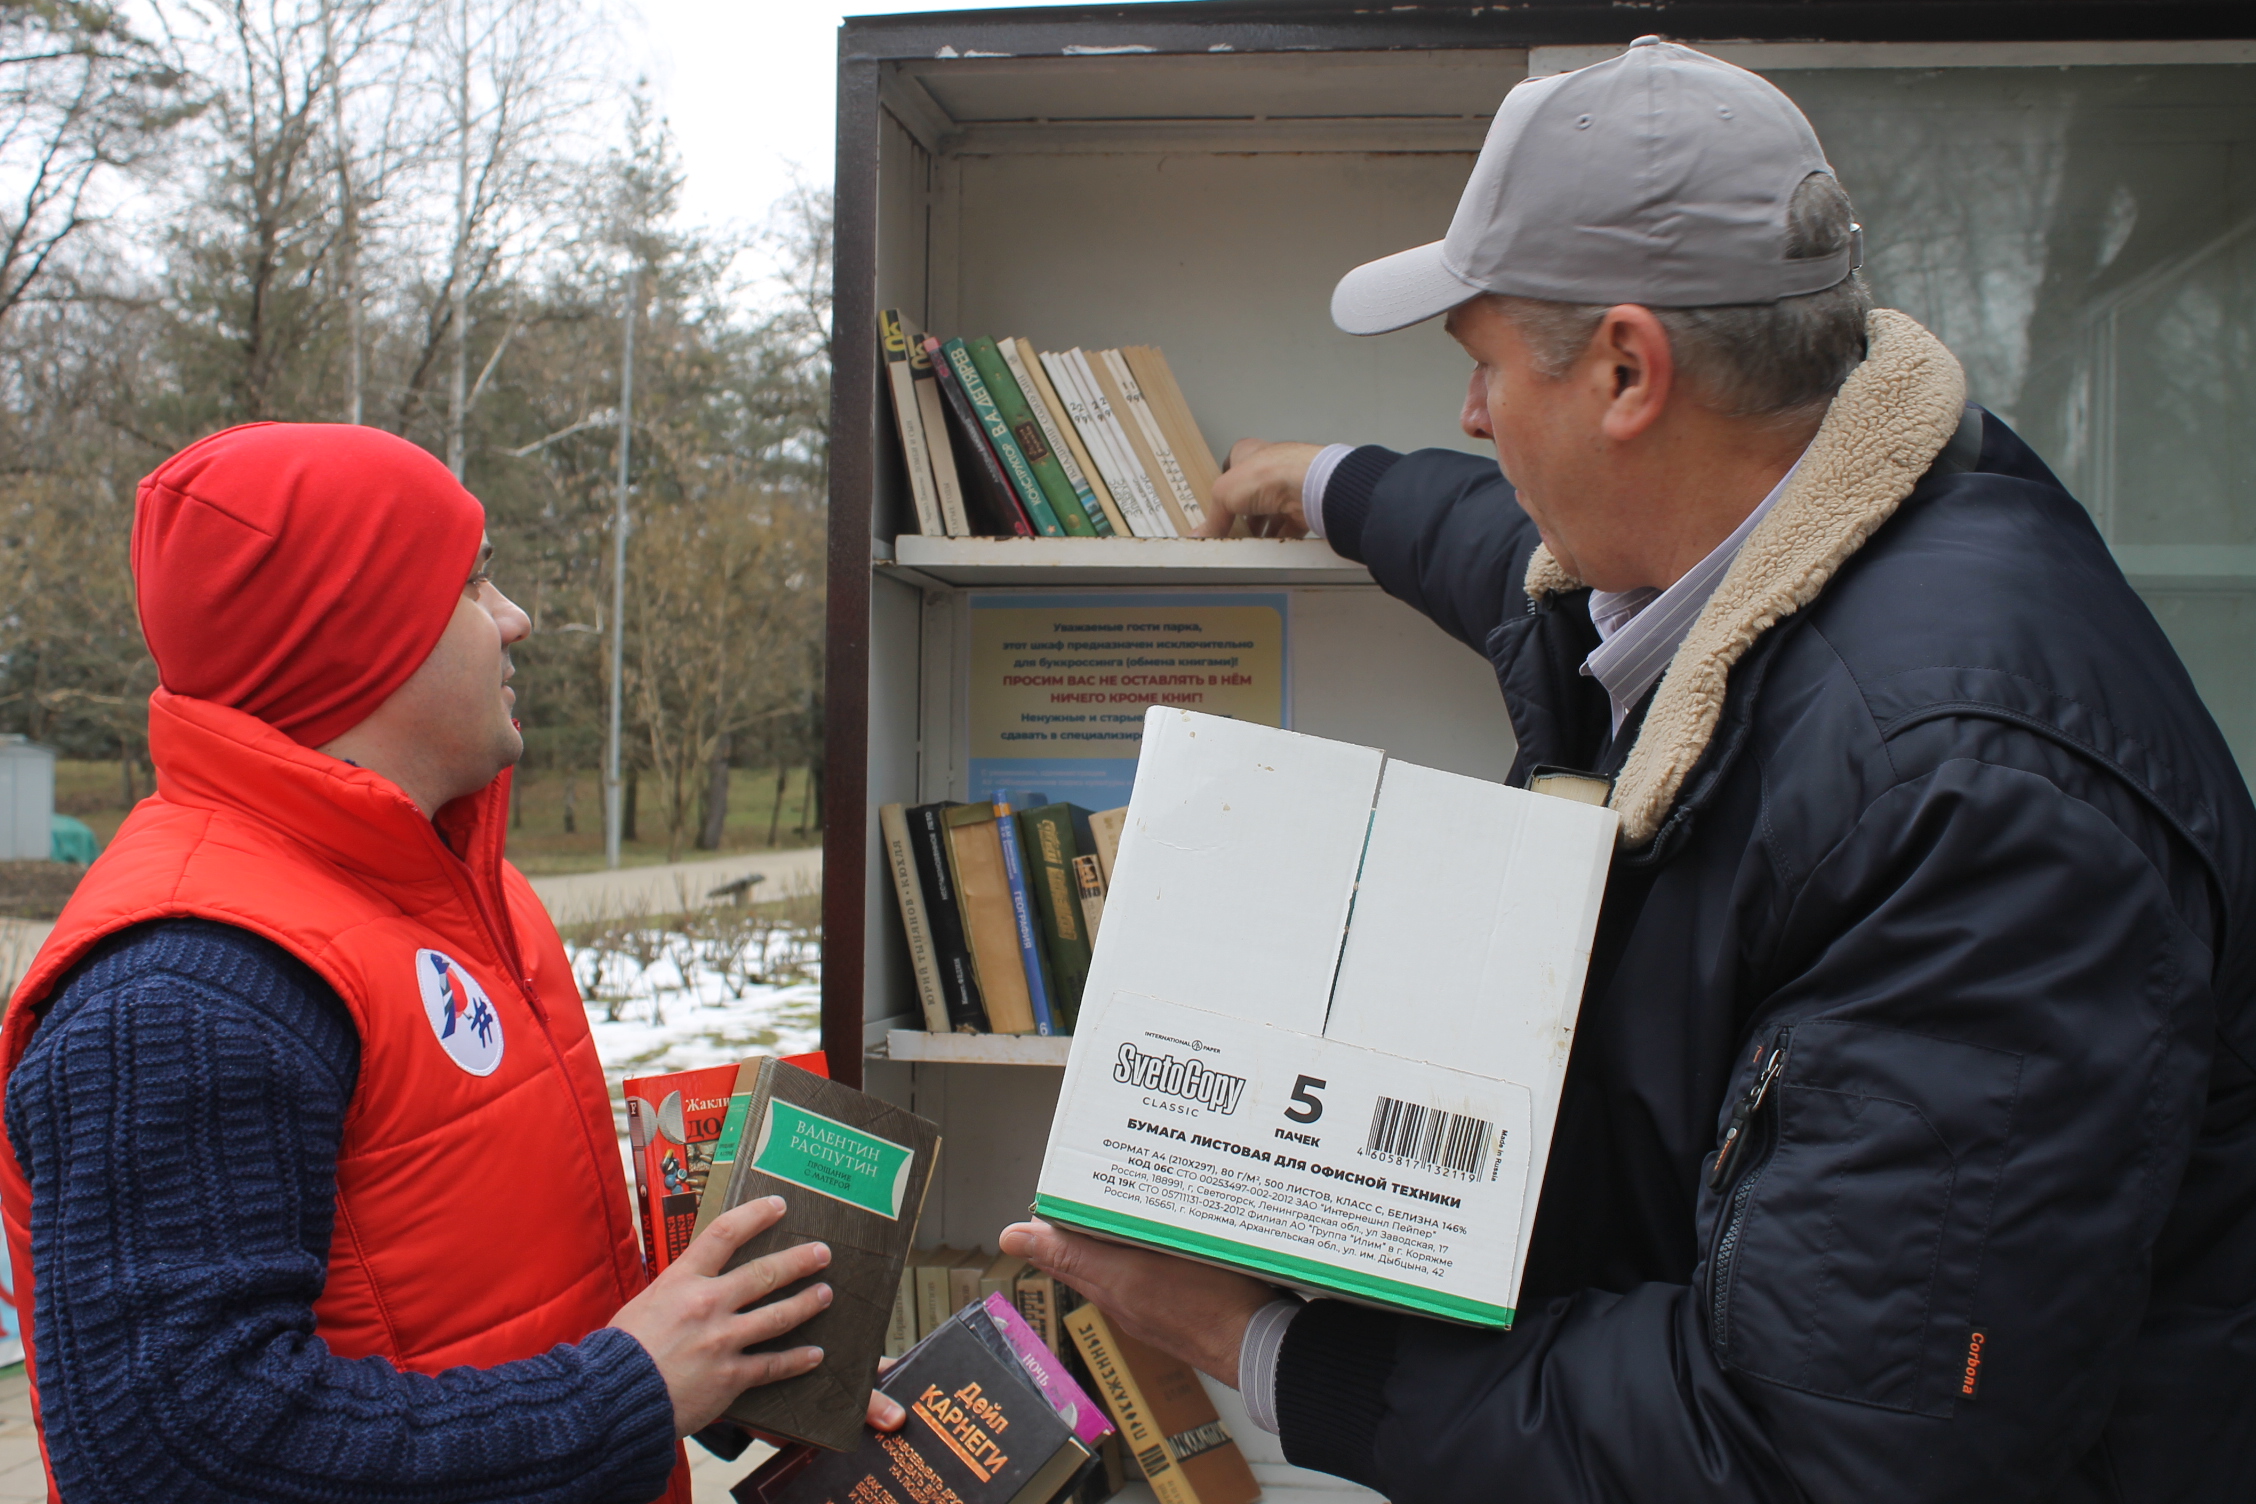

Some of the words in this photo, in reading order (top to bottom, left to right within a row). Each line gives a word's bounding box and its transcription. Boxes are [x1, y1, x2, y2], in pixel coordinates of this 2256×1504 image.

[951, 346, 992, 407] ДЕГТЯРЕВ
[1017, 374, 1047, 425] СОЛОУХИН
[1045, 426, 1078, 479] ВЛАДИМИР
[1001, 443, 1041, 506] КОНСТРУКТОР
[1003, 642, 1027, 650] этот
[1030, 641, 1064, 652] шкаф
[1067, 641, 1153, 651] предназначен
[1156, 640, 1254, 649] исключительно
[1053, 622, 1124, 633] Уважаемые
[1126, 623, 1160, 631] гости
[1163, 623, 1202, 633] парка,
[1003, 675, 1063, 686] ПРОСИМ
[1067, 675, 1095, 686] ВАС
[1100, 675, 1118, 686] НЕ
[1121, 675, 1204, 686] ОСТАВЛЯТЬ
[1208, 675, 1217, 685] В
[1220, 672, 1252, 685] НЁМ
[1013, 658, 1036, 668] для
[1039, 657, 1123, 668] буккроссинга
[1126, 657, 1176, 668] (обмена
[1178, 657, 1238, 668] книгами)!
[1050, 693, 1107, 703] НИЧЕГО
[1110, 693, 1159, 703] КРОМЕ
[1161, 692, 1203, 703] КНИГ!
[1001, 732, 1047, 741] сдавать
[1050, 732, 1057, 740] в
[1021, 713, 1086, 724] Ненужные
[1100, 714, 1144, 724] старые
[924, 811, 935, 831] ЛЕТО
[893, 840, 910, 888] КЮХЛЯ
[905, 898, 927, 964] ТЫНЯНОВ
[1014, 890, 1032, 949] ГЕОГРАФИЯ
[918, 965, 936, 1006] ЮРИЙ
[1144, 1031, 1191, 1047] INTERNATIONAL
[1203, 1045, 1221, 1054] PAPER
[1113, 1042, 1246, 1116] SvetoCopy
[1284, 1073, 1327, 1124] 5
[1142, 1096, 1200, 1117] CLASSIC
[790, 1136, 878, 1177] РАСПУТИН
[796, 1120, 881, 1161] ВАЛЕНТИН
[1274, 1128, 1321, 1148] ПАЧЕК
[1357, 1148, 1364, 1157] 4
[1498, 1129, 1508, 1149] Made
[804, 1169, 811, 1177] С
[812, 1172, 851, 1191] МАТЕРОЙ
[807, 1160, 852, 1182] ПРОЩАНИЕ
[1127, 1117, 1187, 1142] БУМАГА
[1190, 1133, 1272, 1162] ЛИСТОВАЯ
[1273, 1155, 1307, 1171] ДЛЯ
[1310, 1163, 1387, 1191] ОФИСНОЙ
[1391, 1182, 1462, 1209] ТЕХНИКИ
[1491, 1157, 1502, 1182] Russia
[1103, 1138, 1150, 1157] ФОРМАТ
[1151, 1150, 1166, 1162] А4
[1221, 1167, 1235, 1178] 80
[1264, 1178, 1284, 1190] 500
[1285, 1183, 1333, 1204] ЛИСТОВ,
[1335, 1195, 1373, 1213] КЛАСС
[1375, 1205, 1385, 1217] С,
[1387, 1208, 1439, 1229] БЕЛИЗНА
[1441, 1221, 1468, 1236] 146%
[1127, 1156, 1151, 1171] КОД
[1153, 1163, 1174, 1175] 06С
[1176, 1168, 1198, 1180] СТО
[1199, 1174, 1293, 1205] 00253497-002-2012
[1294, 1198, 1318, 1210] ЗАО
[1320, 1203, 1390, 1229] "Интернешнл
[1392, 1221, 1437, 1241] Пейпер"
[1092, 1171, 1116, 1185] КОД
[1118, 1177, 1136, 1189] 19К
[1138, 1182, 1160, 1194] СТО
[1161, 1188, 1245, 1216] 05711131-023-2012
[1247, 1210, 1287, 1227] Филиал
[1289, 1221, 1306, 1231] АО
[1309, 1224, 1347, 1243] "Группа
[1350, 1234, 1386, 1251] "Илим"
[1405, 1249, 1453, 1268] Коряжме
[1111, 1164, 1149, 1182] Россия,
[1151, 1173, 1185, 1191] 188991,
[1196, 1185, 1256, 1209] Светогорск,
[1258, 1200, 1338, 1227] Ленинградская
[1340, 1219, 1364, 1235] обл.,
[1365, 1227, 1378, 1238] ул
[1380, 1230, 1436, 1252] Заводская,
[1438, 1244, 1449, 1254] 17
[1104, 1186, 1143, 1205] Россия,
[1145, 1195, 1178, 1213] 165651,
[1179, 1206, 1186, 1214] г.
[1189, 1208, 1237, 1228] Коряжма,
[1239, 1220, 1315, 1245] Архангельская
[1317, 1239, 1341, 1255] обл.,
[1343, 1247, 1357, 1258] ул.
[1359, 1251, 1376, 1262] им.
[1377, 1254, 1429, 1275] Дыбцына,
[1431, 1267, 1445, 1278] 42
[1022, 1353, 1049, 1387] НОЧЬ
[1078, 1322, 1148, 1441] ПРОКАЖЕННЫЕ
[1962, 1332, 1985, 1395] Corbona
[953, 1381, 1010, 1435] Дейл
[919, 1383, 1009, 1475] КАРНЕГИ
[874, 1432, 885, 1442] И
[882, 1439, 925, 1488] ОКАЗЫВАТЬ
[889, 1464, 904, 1479] НА
[892, 1435, 944, 1491] ЗАВОЕВЫВАТЬ
[864, 1474, 882, 1493] КАК
